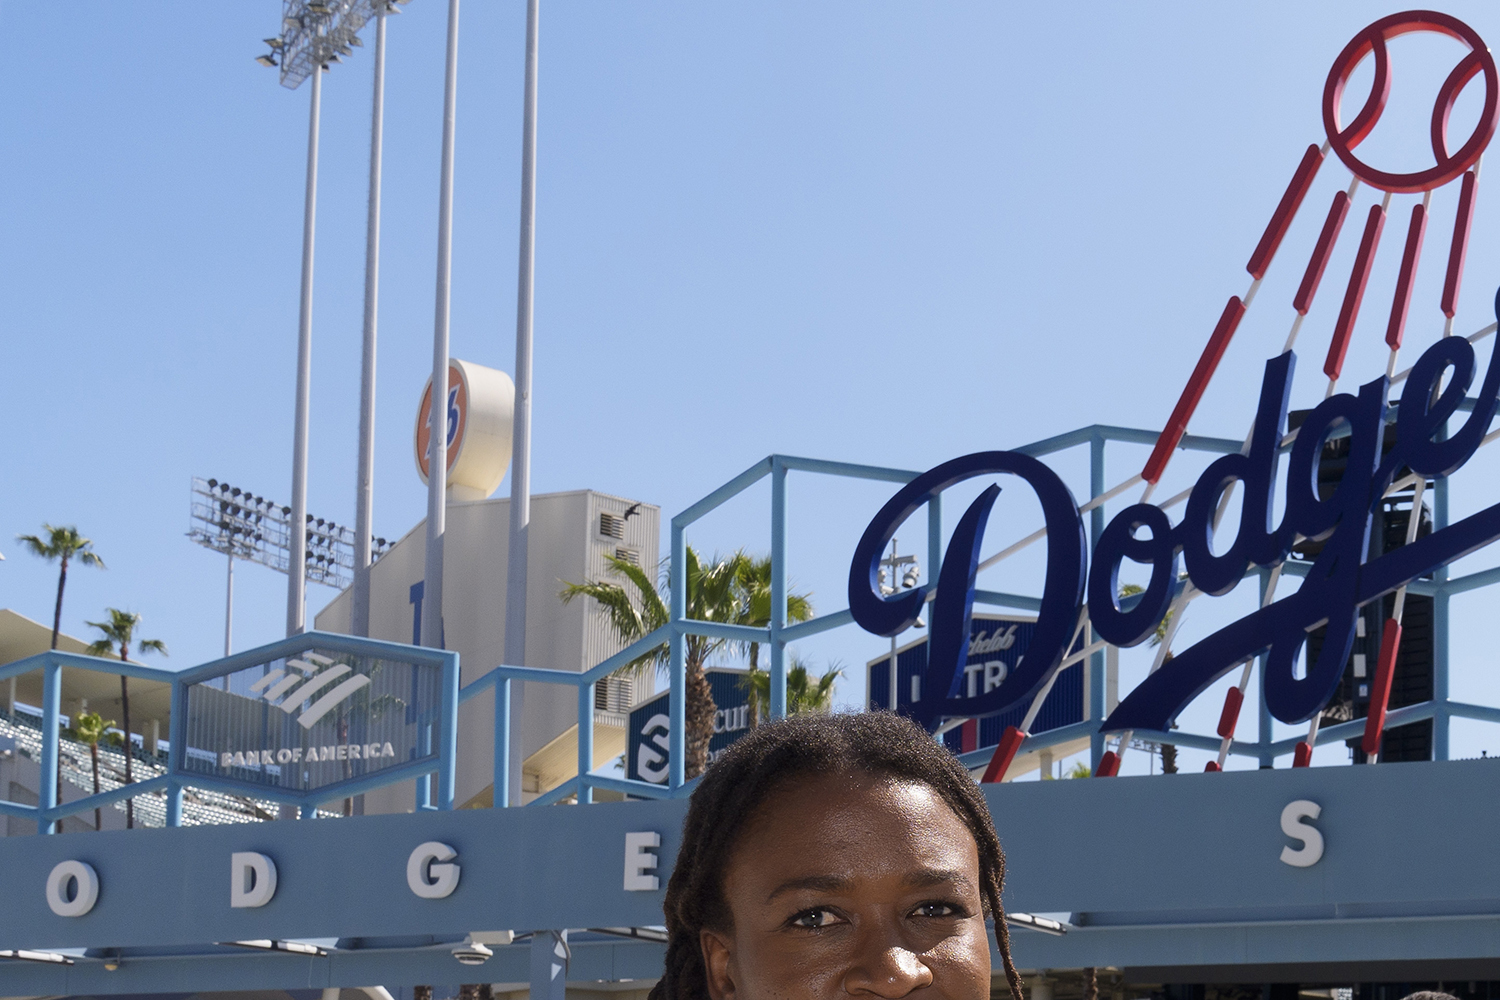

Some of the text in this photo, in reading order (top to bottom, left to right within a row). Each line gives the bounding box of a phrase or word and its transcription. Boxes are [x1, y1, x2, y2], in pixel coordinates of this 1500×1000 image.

[221, 741, 395, 767] BANK OF AMERICA
